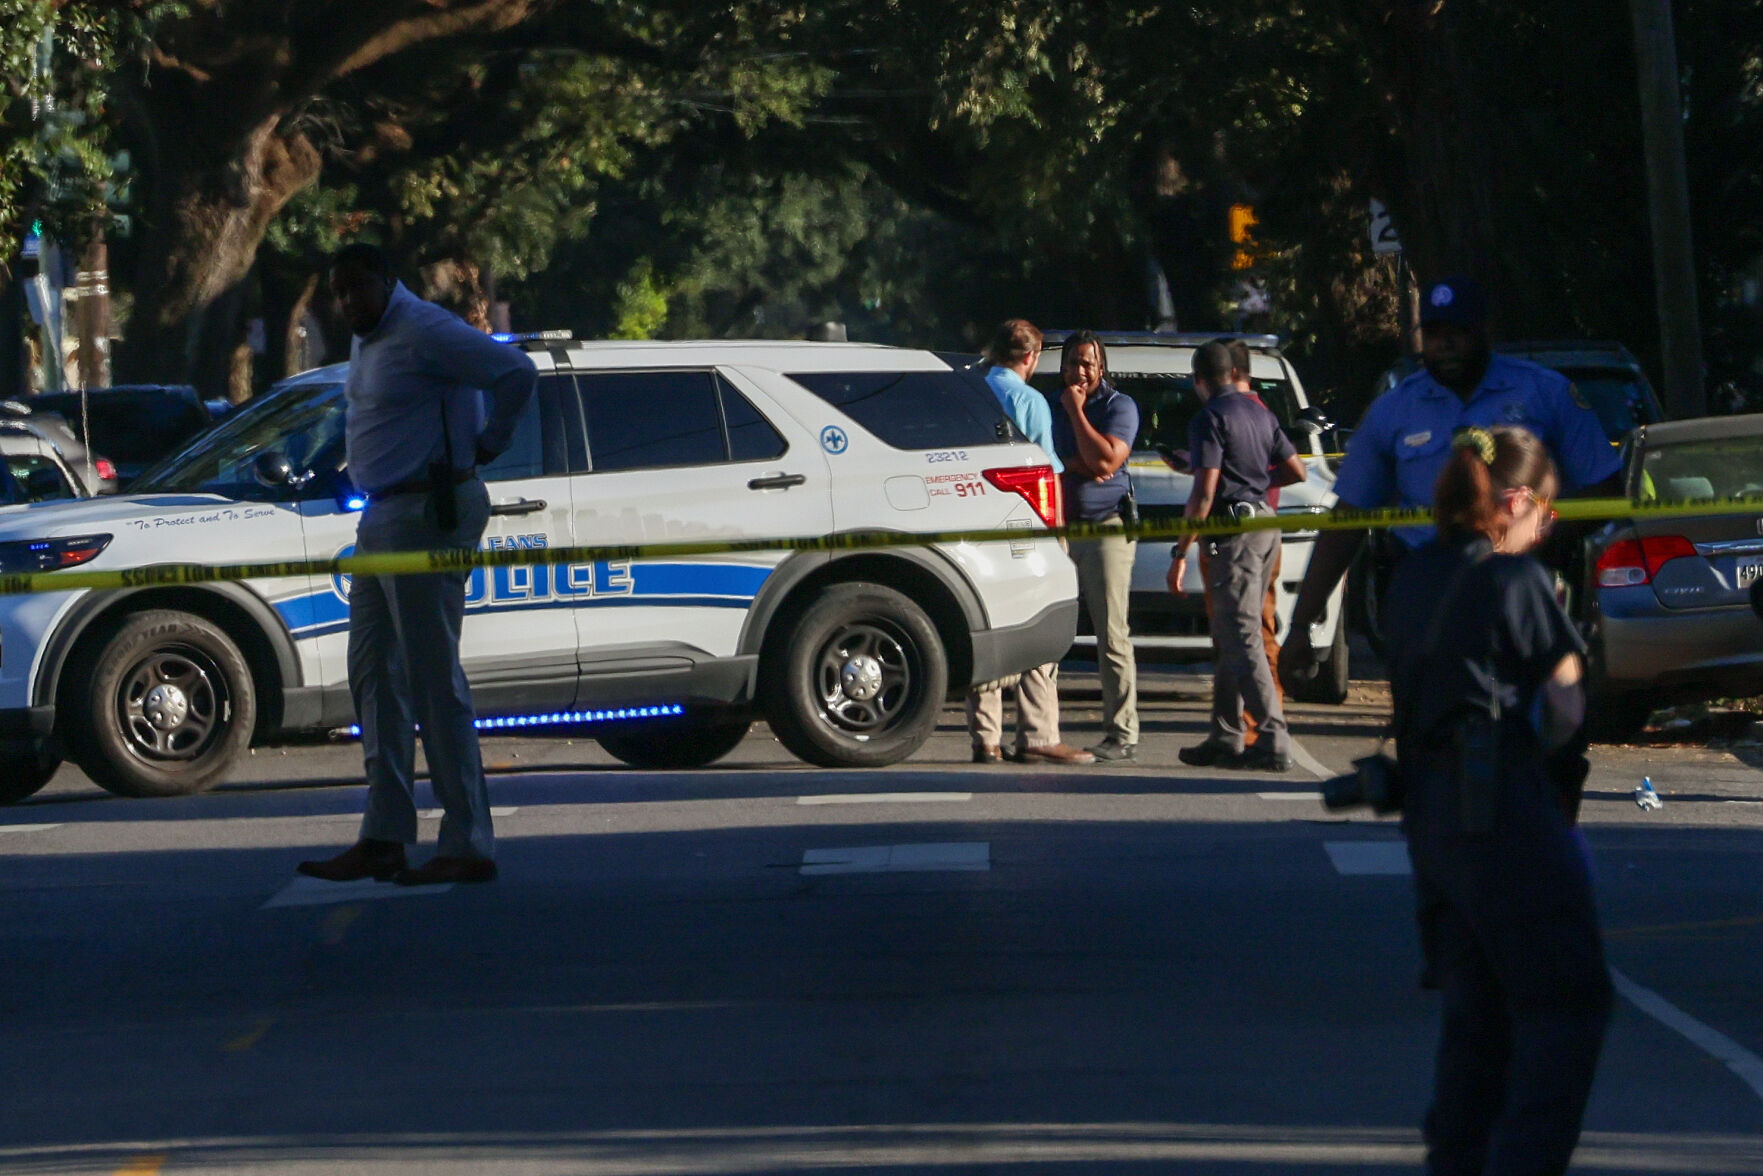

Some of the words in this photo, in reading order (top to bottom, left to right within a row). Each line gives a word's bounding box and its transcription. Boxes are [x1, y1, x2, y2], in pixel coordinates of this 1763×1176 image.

[926, 450, 968, 463] 23212
[925, 472, 979, 484] EMERGENCY
[929, 488, 952, 497] CALL
[955, 481, 987, 498] 911
[154, 516, 195, 529] Protect
[199, 512, 220, 523] and
[223, 510, 239, 521] To
[244, 508, 275, 520] Serve
